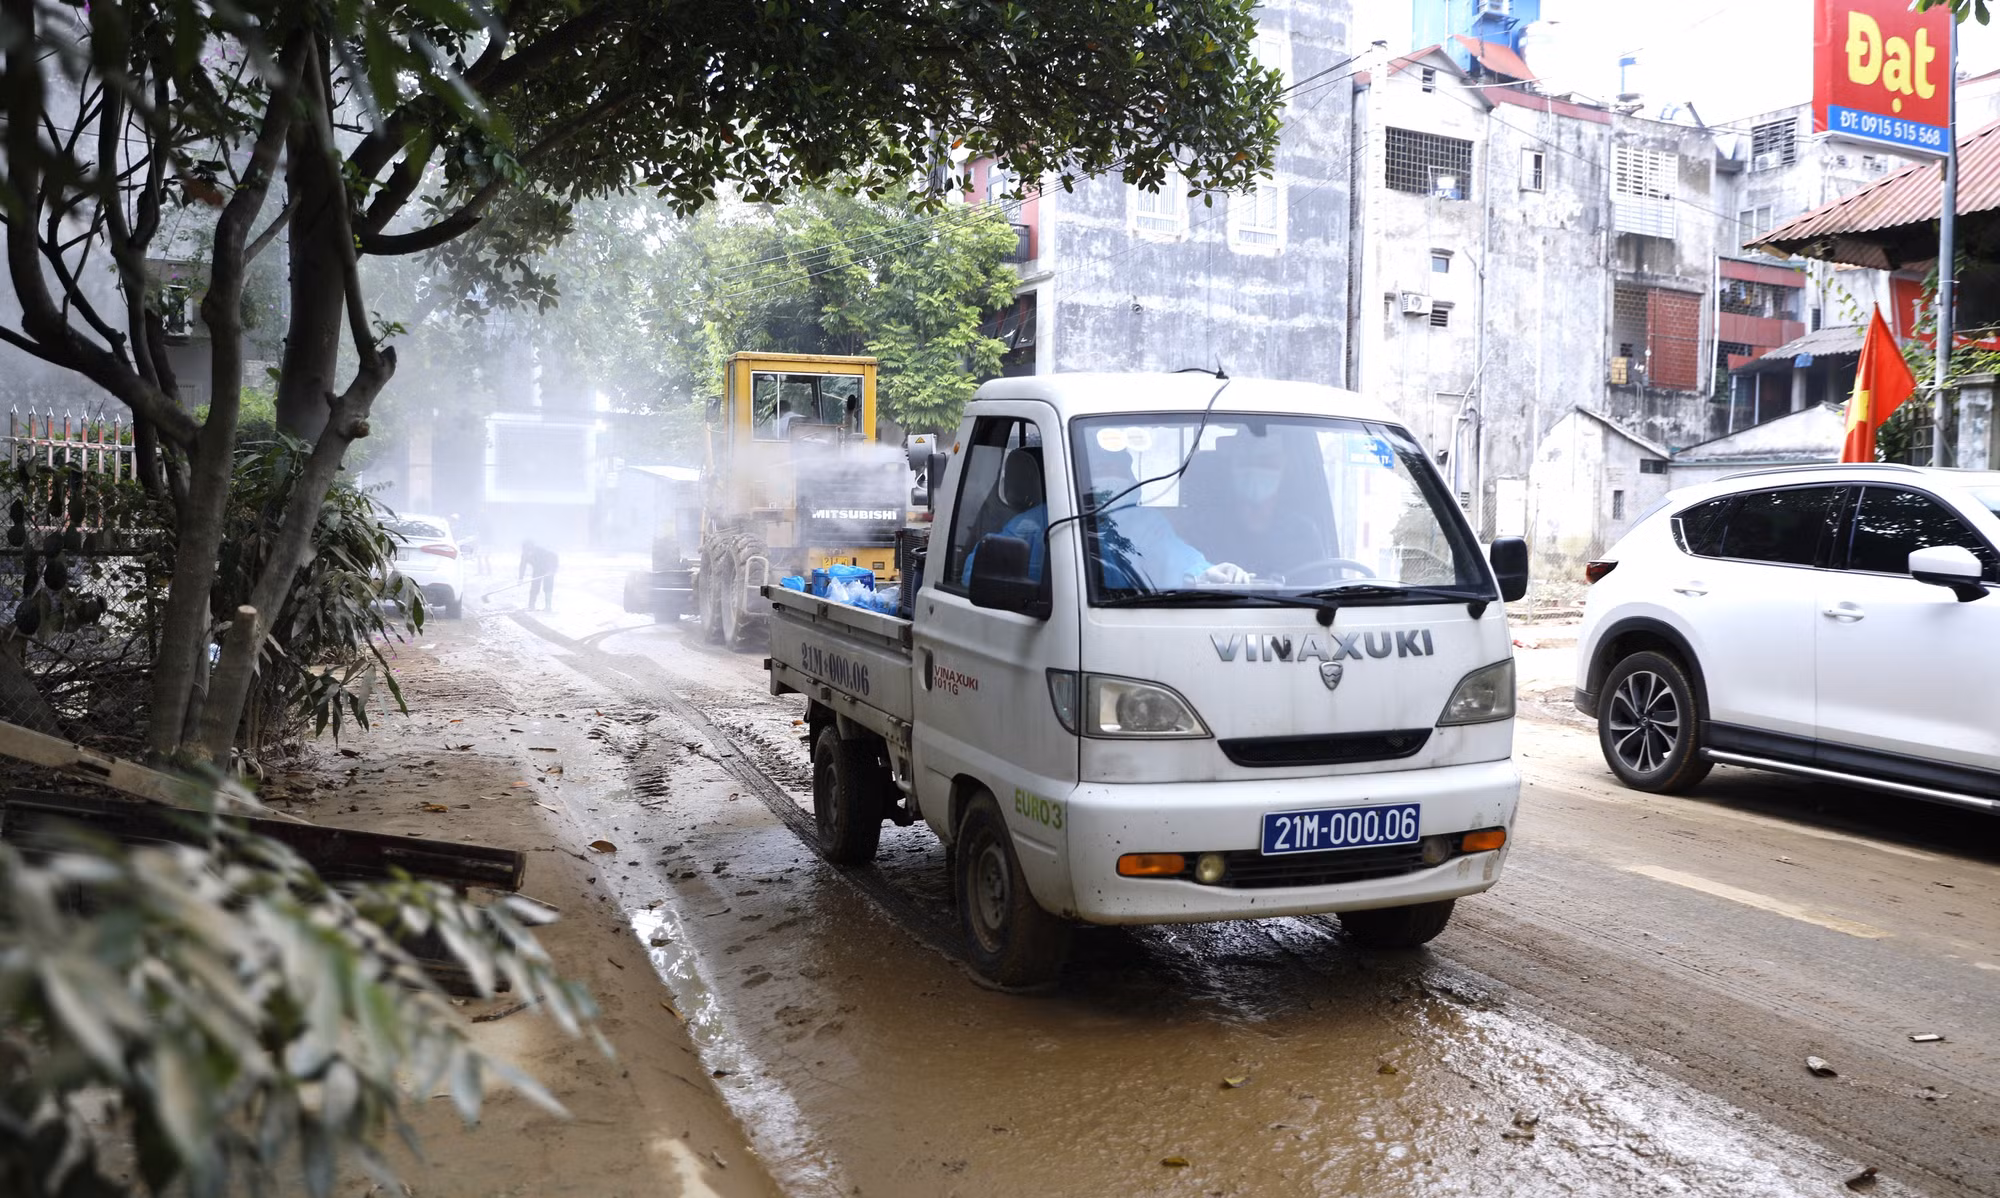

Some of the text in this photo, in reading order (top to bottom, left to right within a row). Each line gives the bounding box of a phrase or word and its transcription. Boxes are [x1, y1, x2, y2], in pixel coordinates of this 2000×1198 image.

[1845, 11, 1936, 113] Đạt
[1861, 115, 1892, 136] 0915
[1894, 121, 1916, 141] 515
[1918, 127, 1941, 146] 568
[812, 509, 897, 520] MITSUBISHI
[1209, 628, 1434, 662] VINAXUKI
[933, 677, 959, 695] 1011G
[934, 665, 979, 691] VINAXUKI
[1273, 807, 1417, 850] 21M-000.06
